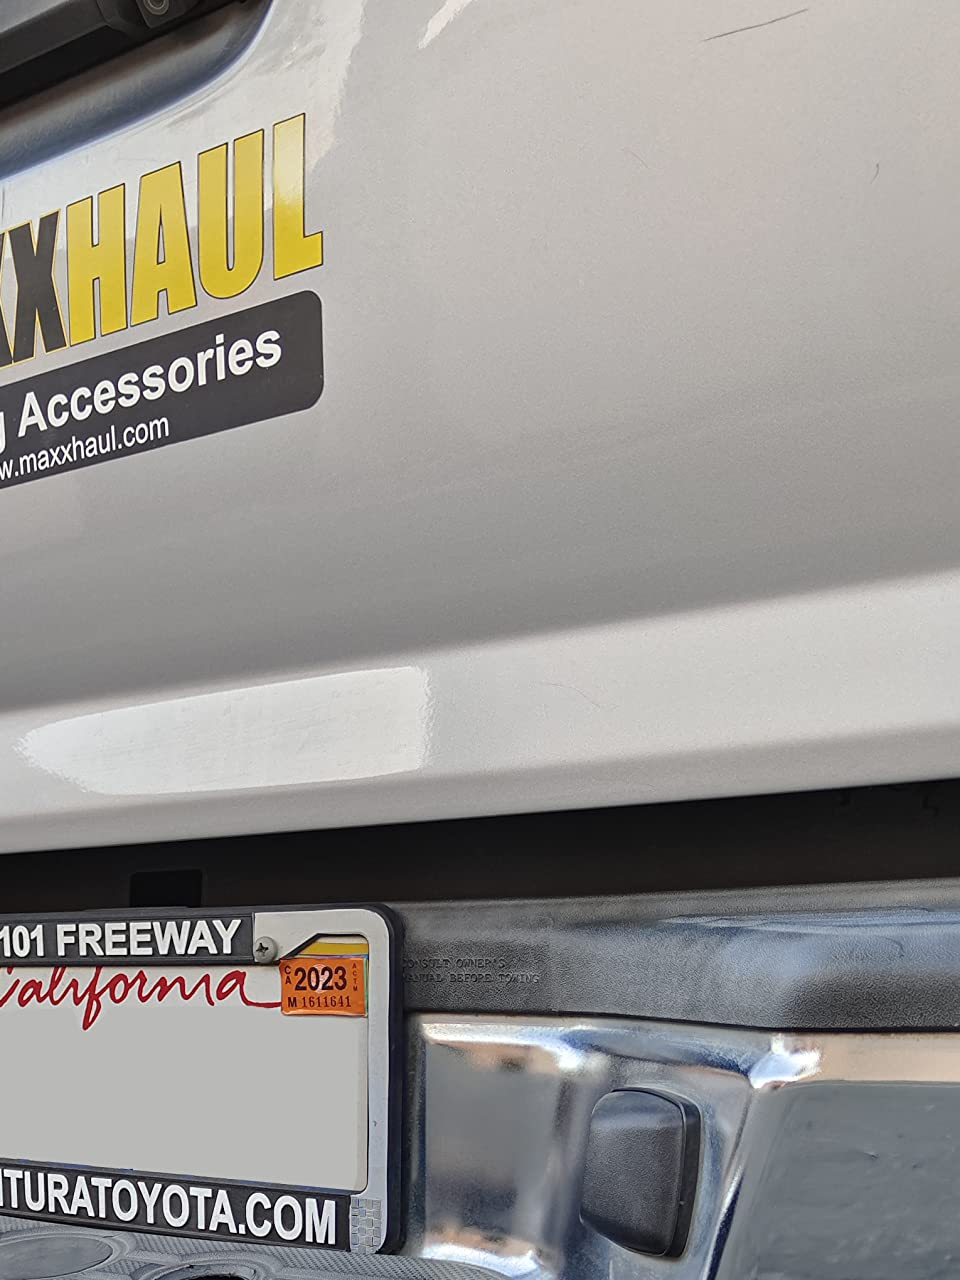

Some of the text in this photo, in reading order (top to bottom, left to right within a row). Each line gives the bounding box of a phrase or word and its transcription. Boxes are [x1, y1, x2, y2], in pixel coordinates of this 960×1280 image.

[17, 330, 282, 437] Accessories
[56, 919, 241, 957] FREEWAY
[294, 965, 347, 991] 2023
[287, 995, 352, 1008] M 1611641
